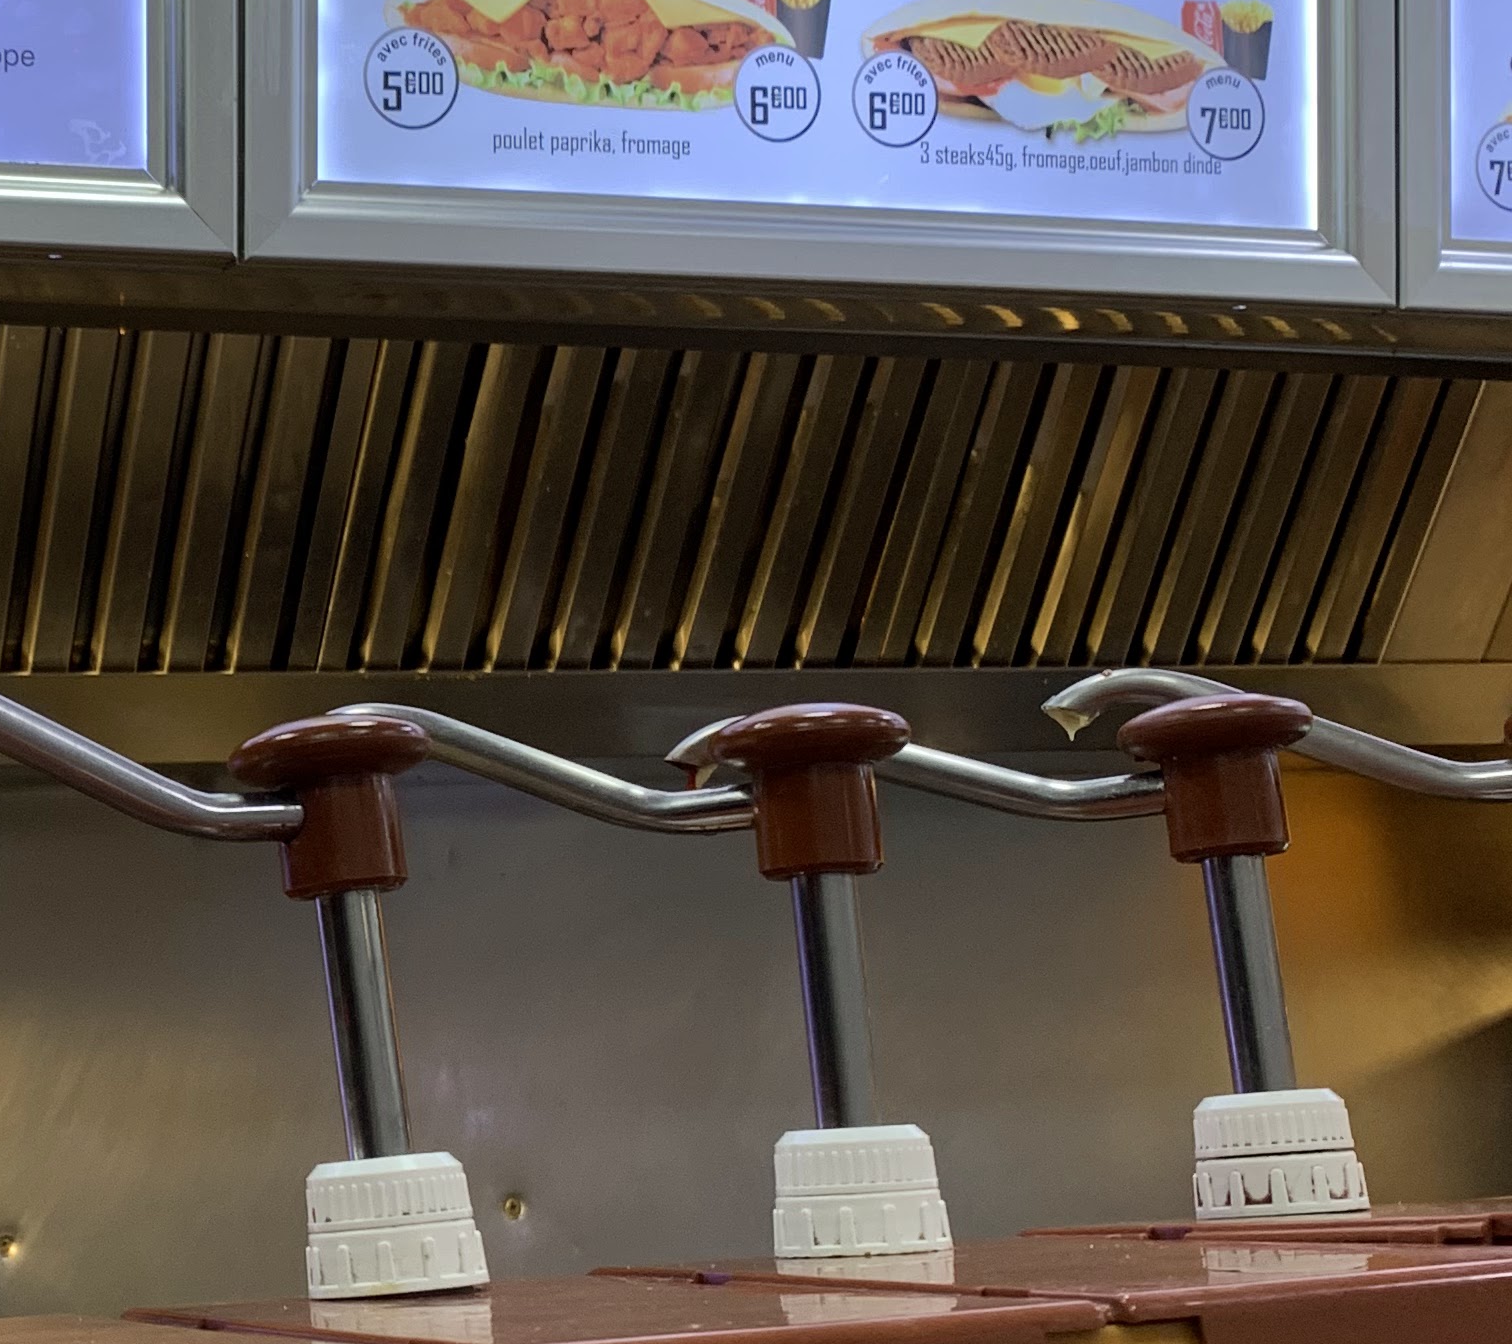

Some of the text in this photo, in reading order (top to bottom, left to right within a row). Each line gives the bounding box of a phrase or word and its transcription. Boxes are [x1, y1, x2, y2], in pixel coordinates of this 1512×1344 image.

[1205, 75, 1241, 90] menu
[493, 128, 691, 159] poulet paprika, fromage
[920, 141, 930, 164] 3
[1183, 152, 1222, 175] dinde
